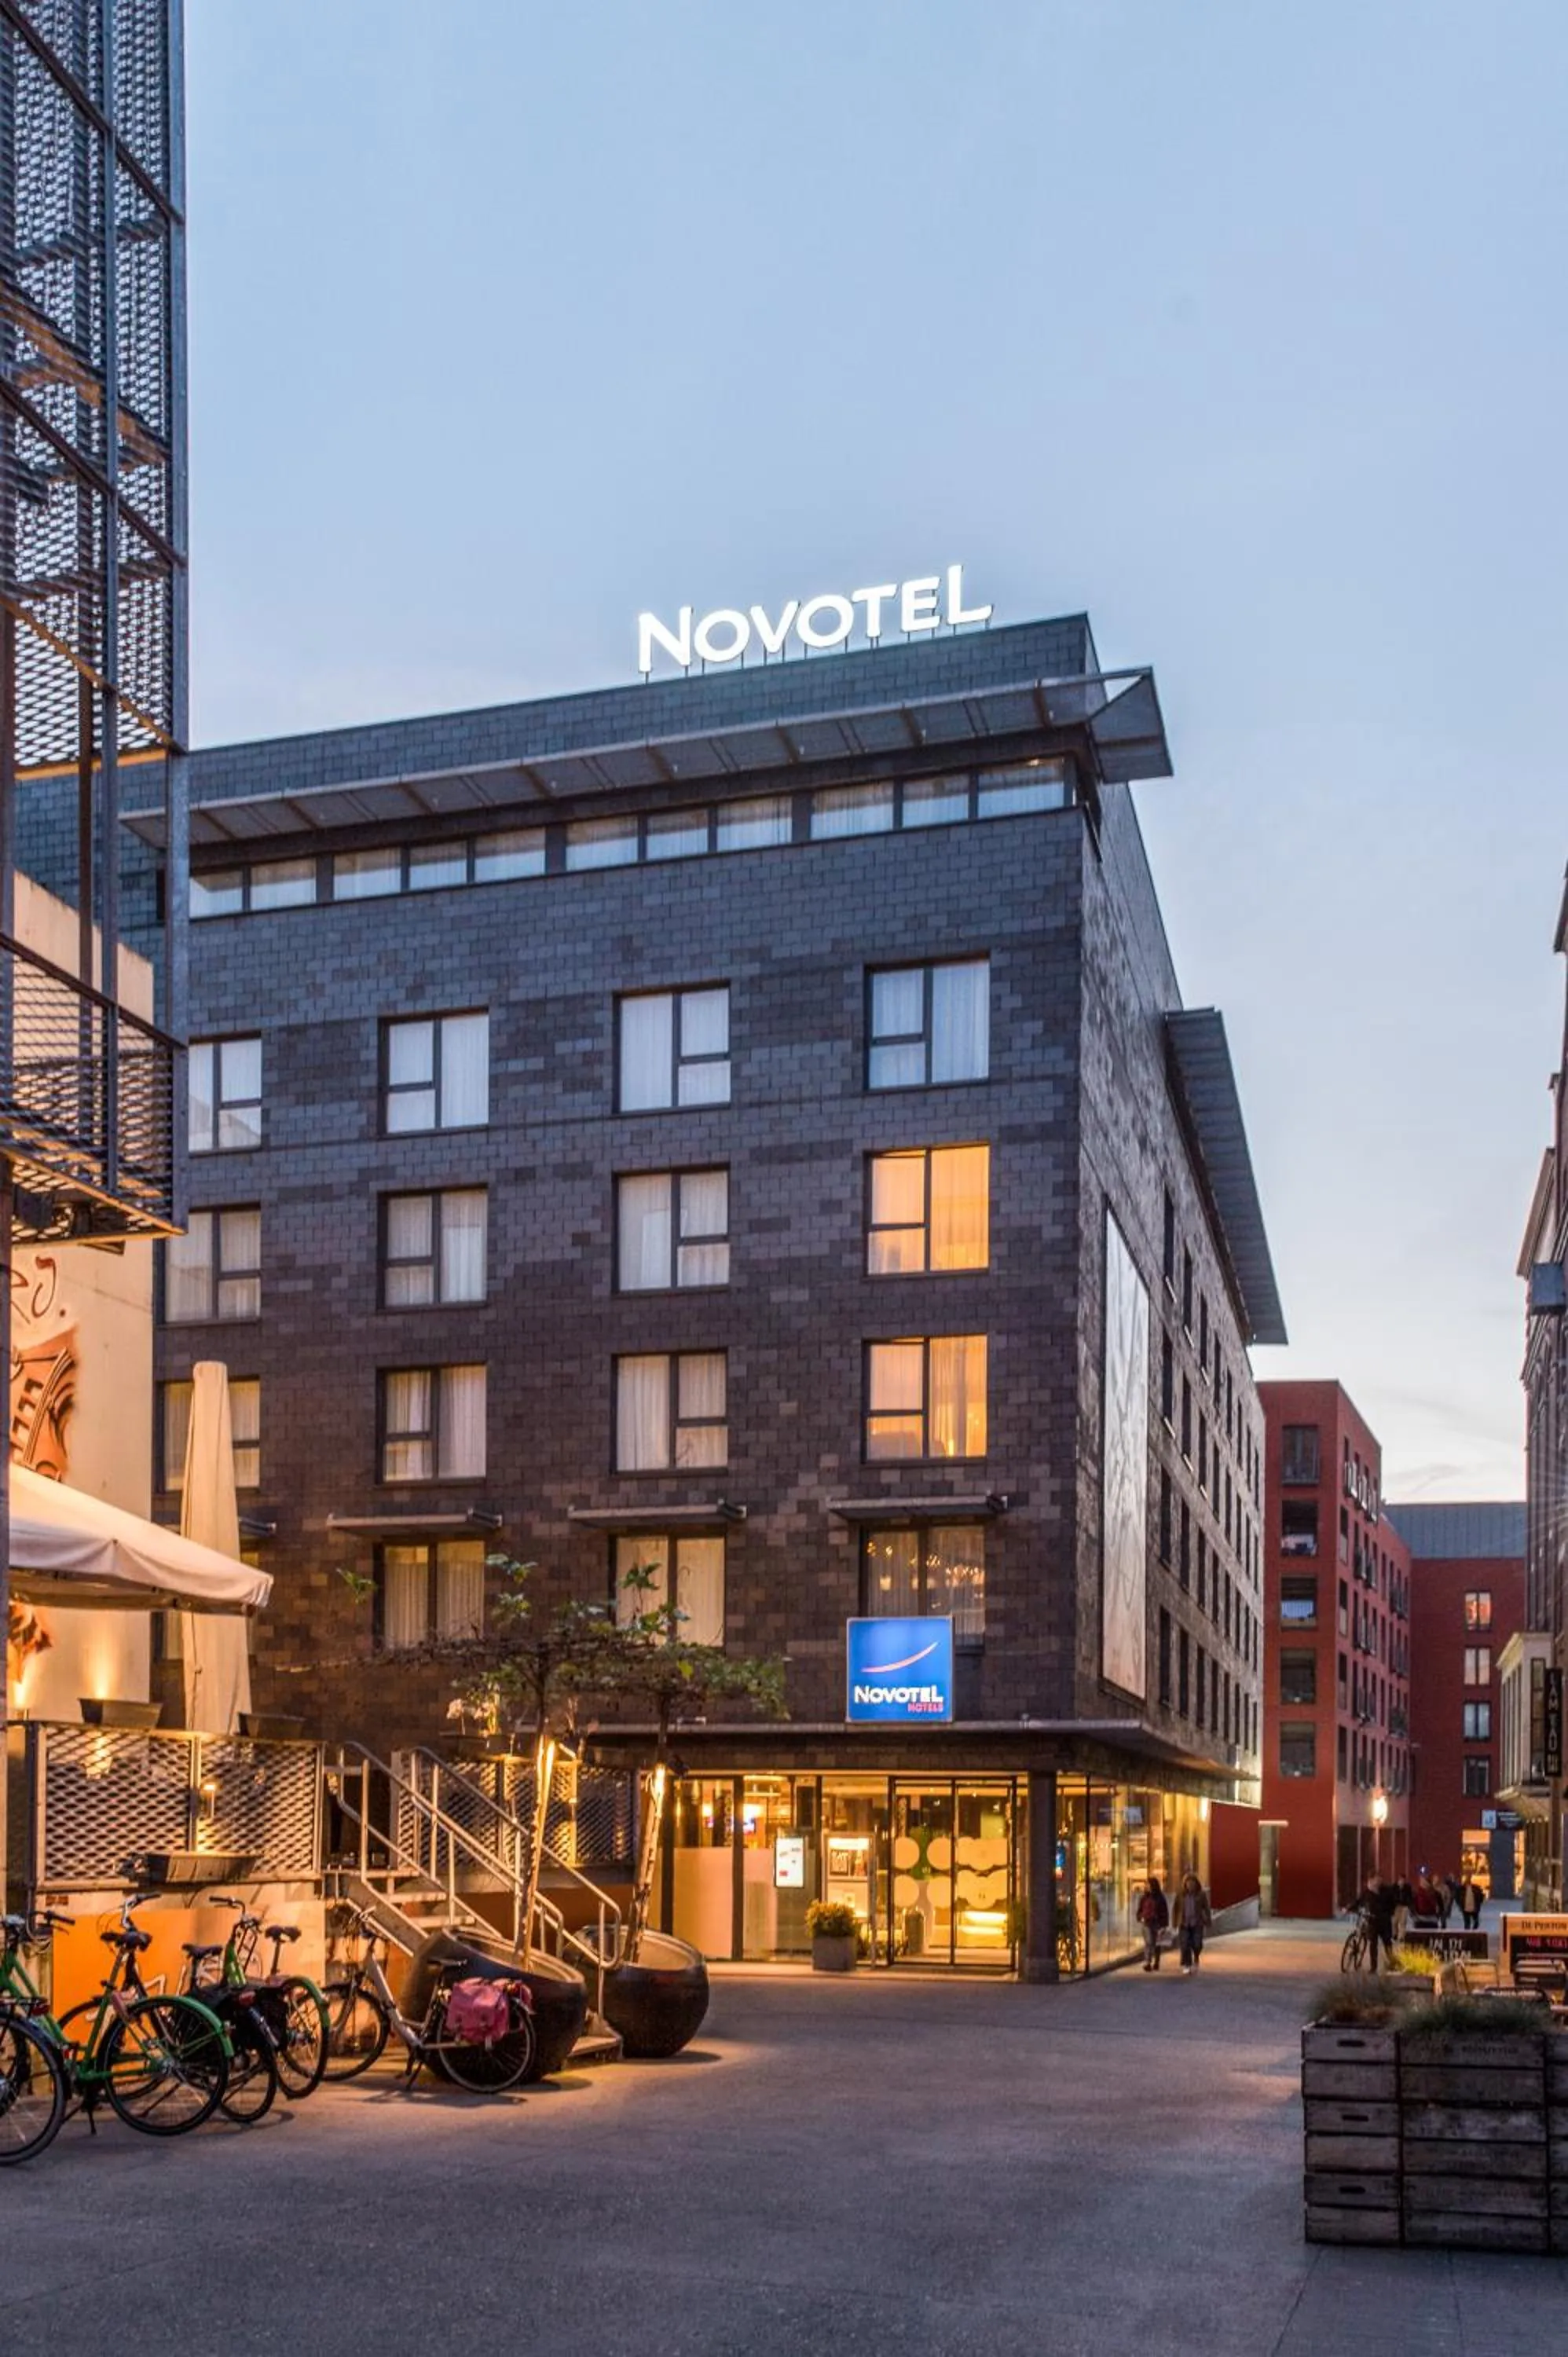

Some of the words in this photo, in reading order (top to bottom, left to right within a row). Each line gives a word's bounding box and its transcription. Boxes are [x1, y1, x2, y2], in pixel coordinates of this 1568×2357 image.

[639, 565, 993, 673] NOVOTEL
[854, 1684, 943, 1704] NOVOTEL
[908, 1703, 943, 1713] HOTELS
